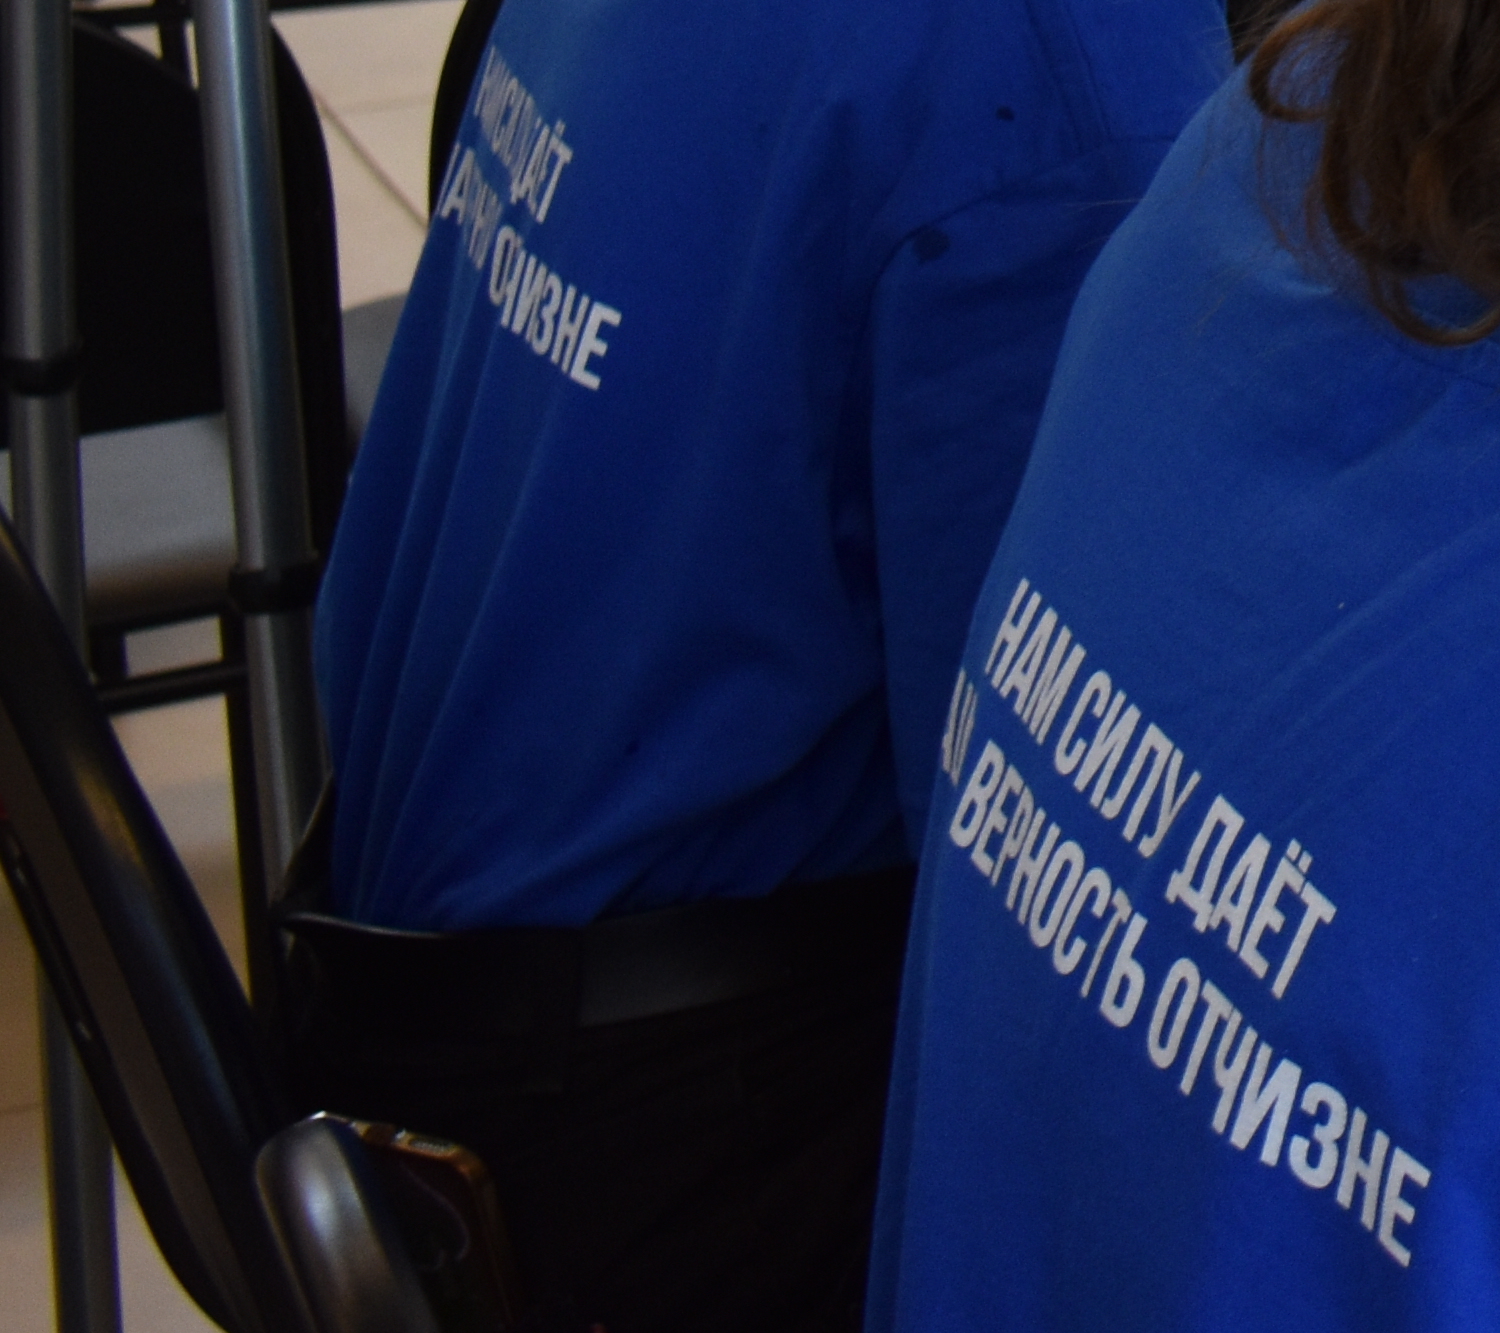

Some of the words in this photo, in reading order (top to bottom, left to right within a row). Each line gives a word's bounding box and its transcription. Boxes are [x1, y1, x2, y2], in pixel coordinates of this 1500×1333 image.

[488, 223, 623, 392] ОЧИЗНЕ
[984, 577, 1088, 746] НАМ
[1053, 670, 1201, 858] СИЛУ
[1165, 794, 1337, 1000] ДАЁТ
[947, 739, 1149, 1030] ВЕРНОСТЬ
[1146, 957, 1432, 1269] ОТЧИЗНЕ
